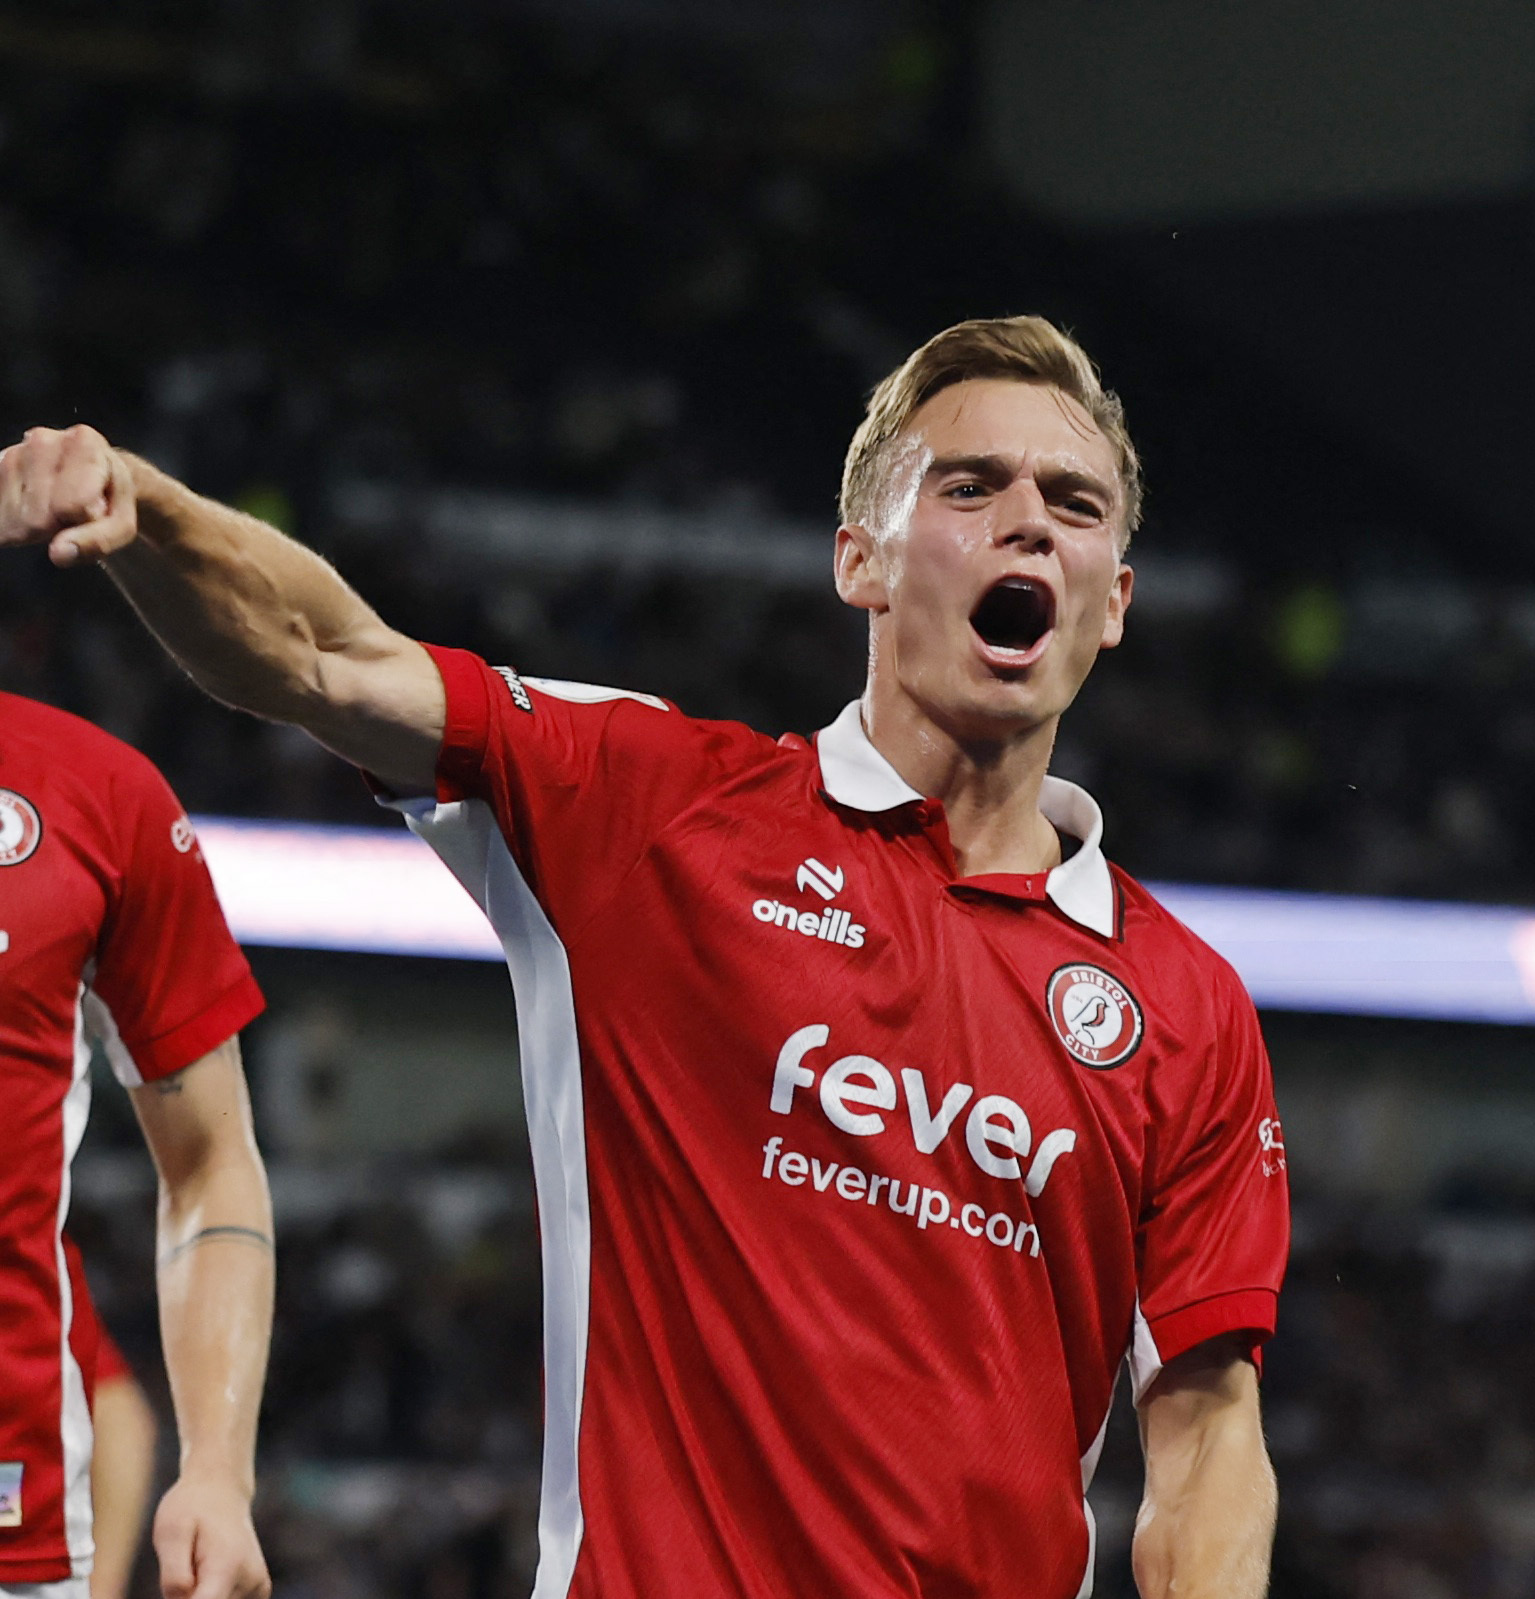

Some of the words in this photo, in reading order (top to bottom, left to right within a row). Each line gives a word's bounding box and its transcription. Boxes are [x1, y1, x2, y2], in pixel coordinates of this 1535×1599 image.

[1071, 971, 1129, 1010] BRISTOL
[1065, 1034, 1100, 1060] CITY
[769, 1024, 1078, 1198] fever
